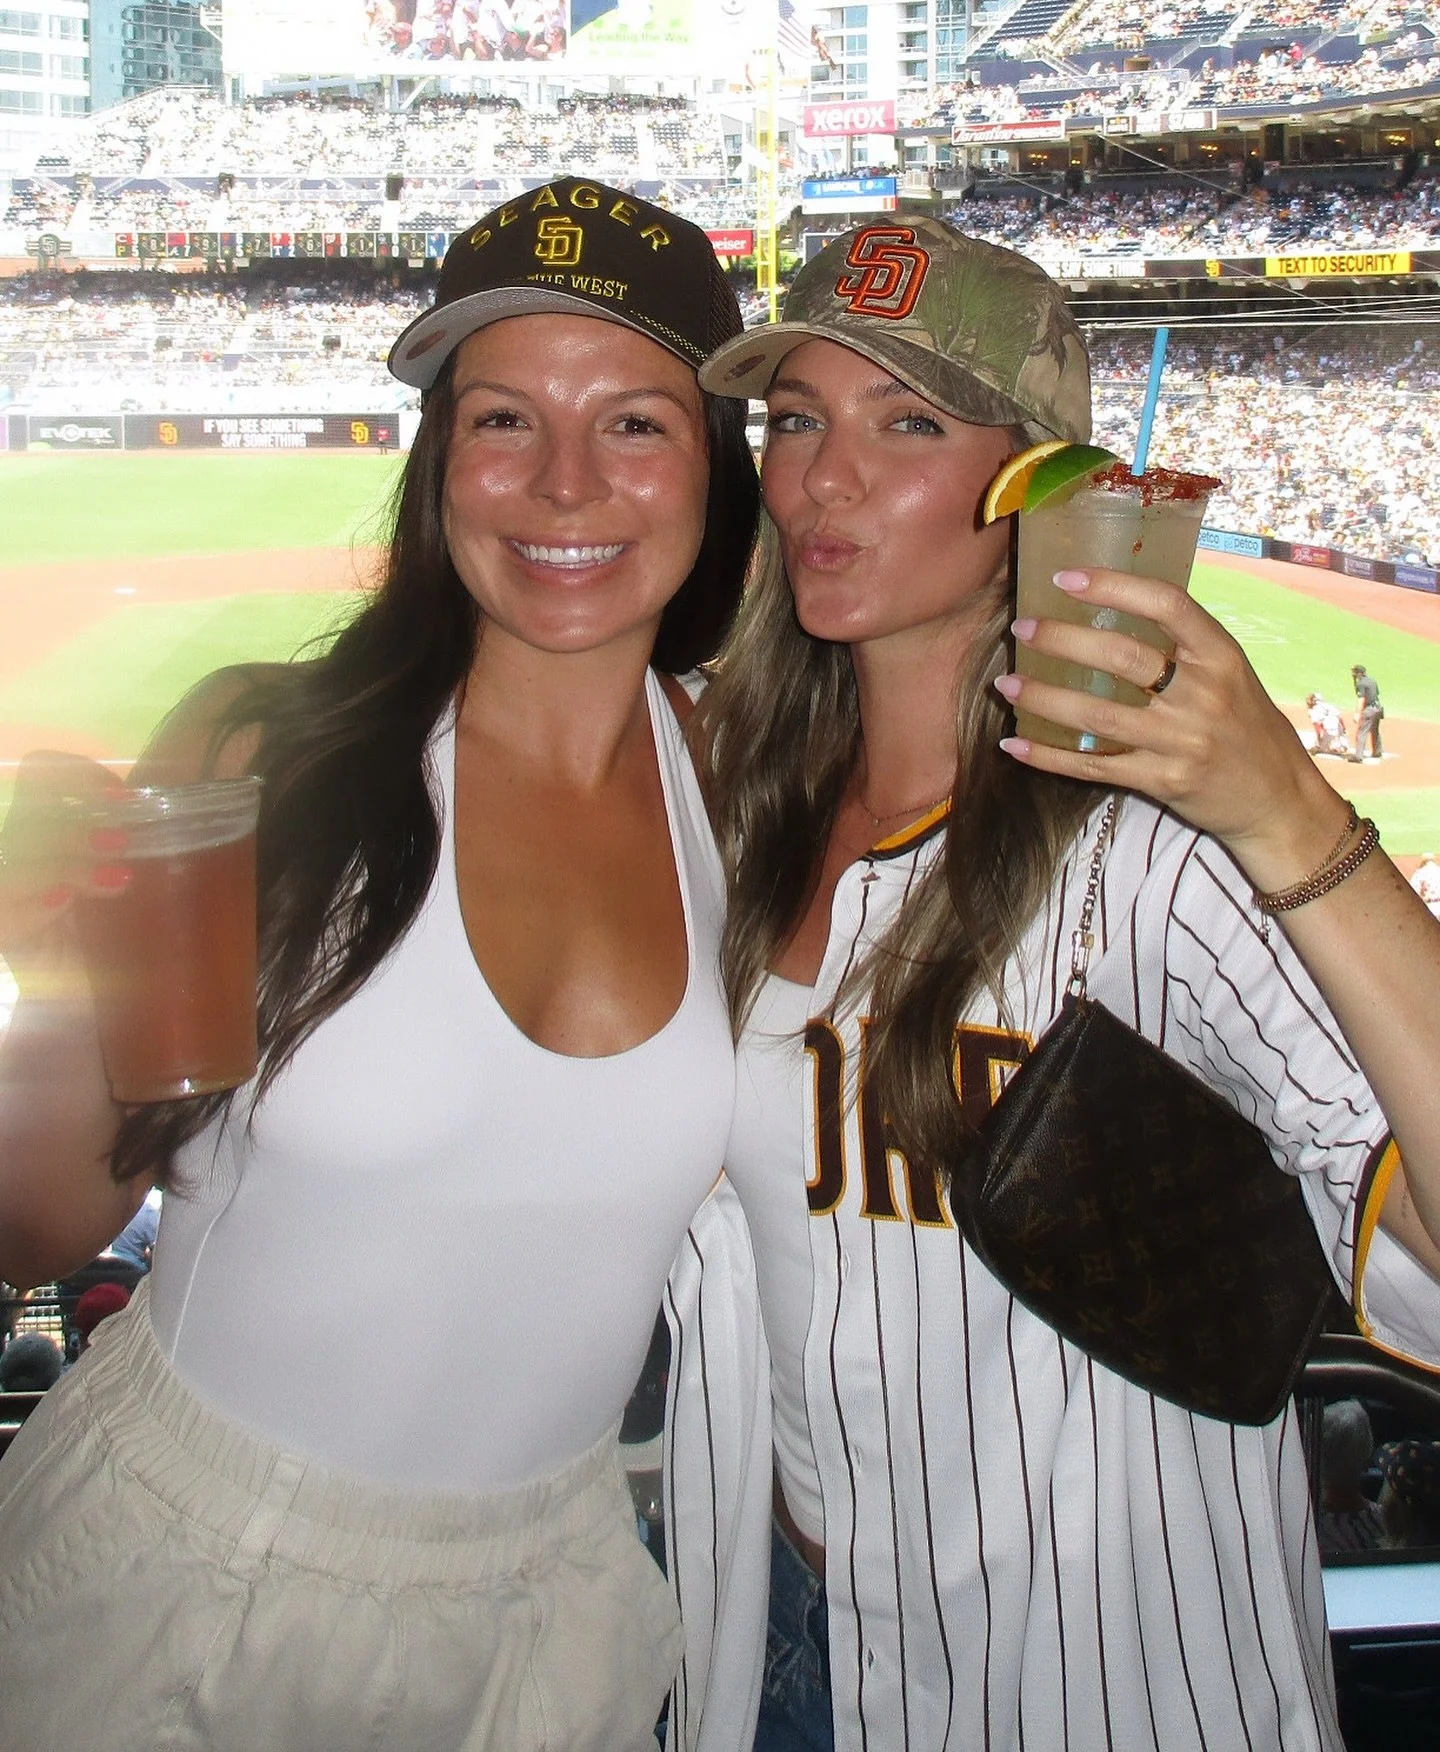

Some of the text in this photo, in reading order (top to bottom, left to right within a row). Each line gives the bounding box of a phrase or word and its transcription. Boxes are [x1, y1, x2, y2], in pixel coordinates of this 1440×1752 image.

[642, 32, 660, 42] the
[812, 105, 886, 132] xerox
[469, 184, 672, 253] SEAGER
[535, 216, 583, 266] SD
[834, 226, 931, 320] SD
[1278, 253, 1397, 273] TEXT TO SECURITY
[570, 274, 627, 300] WEST
[203, 419, 324, 433] IF YOU SEE SOMETHING
[221, 433, 306, 448] SAY SOMETHING
[1234, 537, 1259, 552] petco
